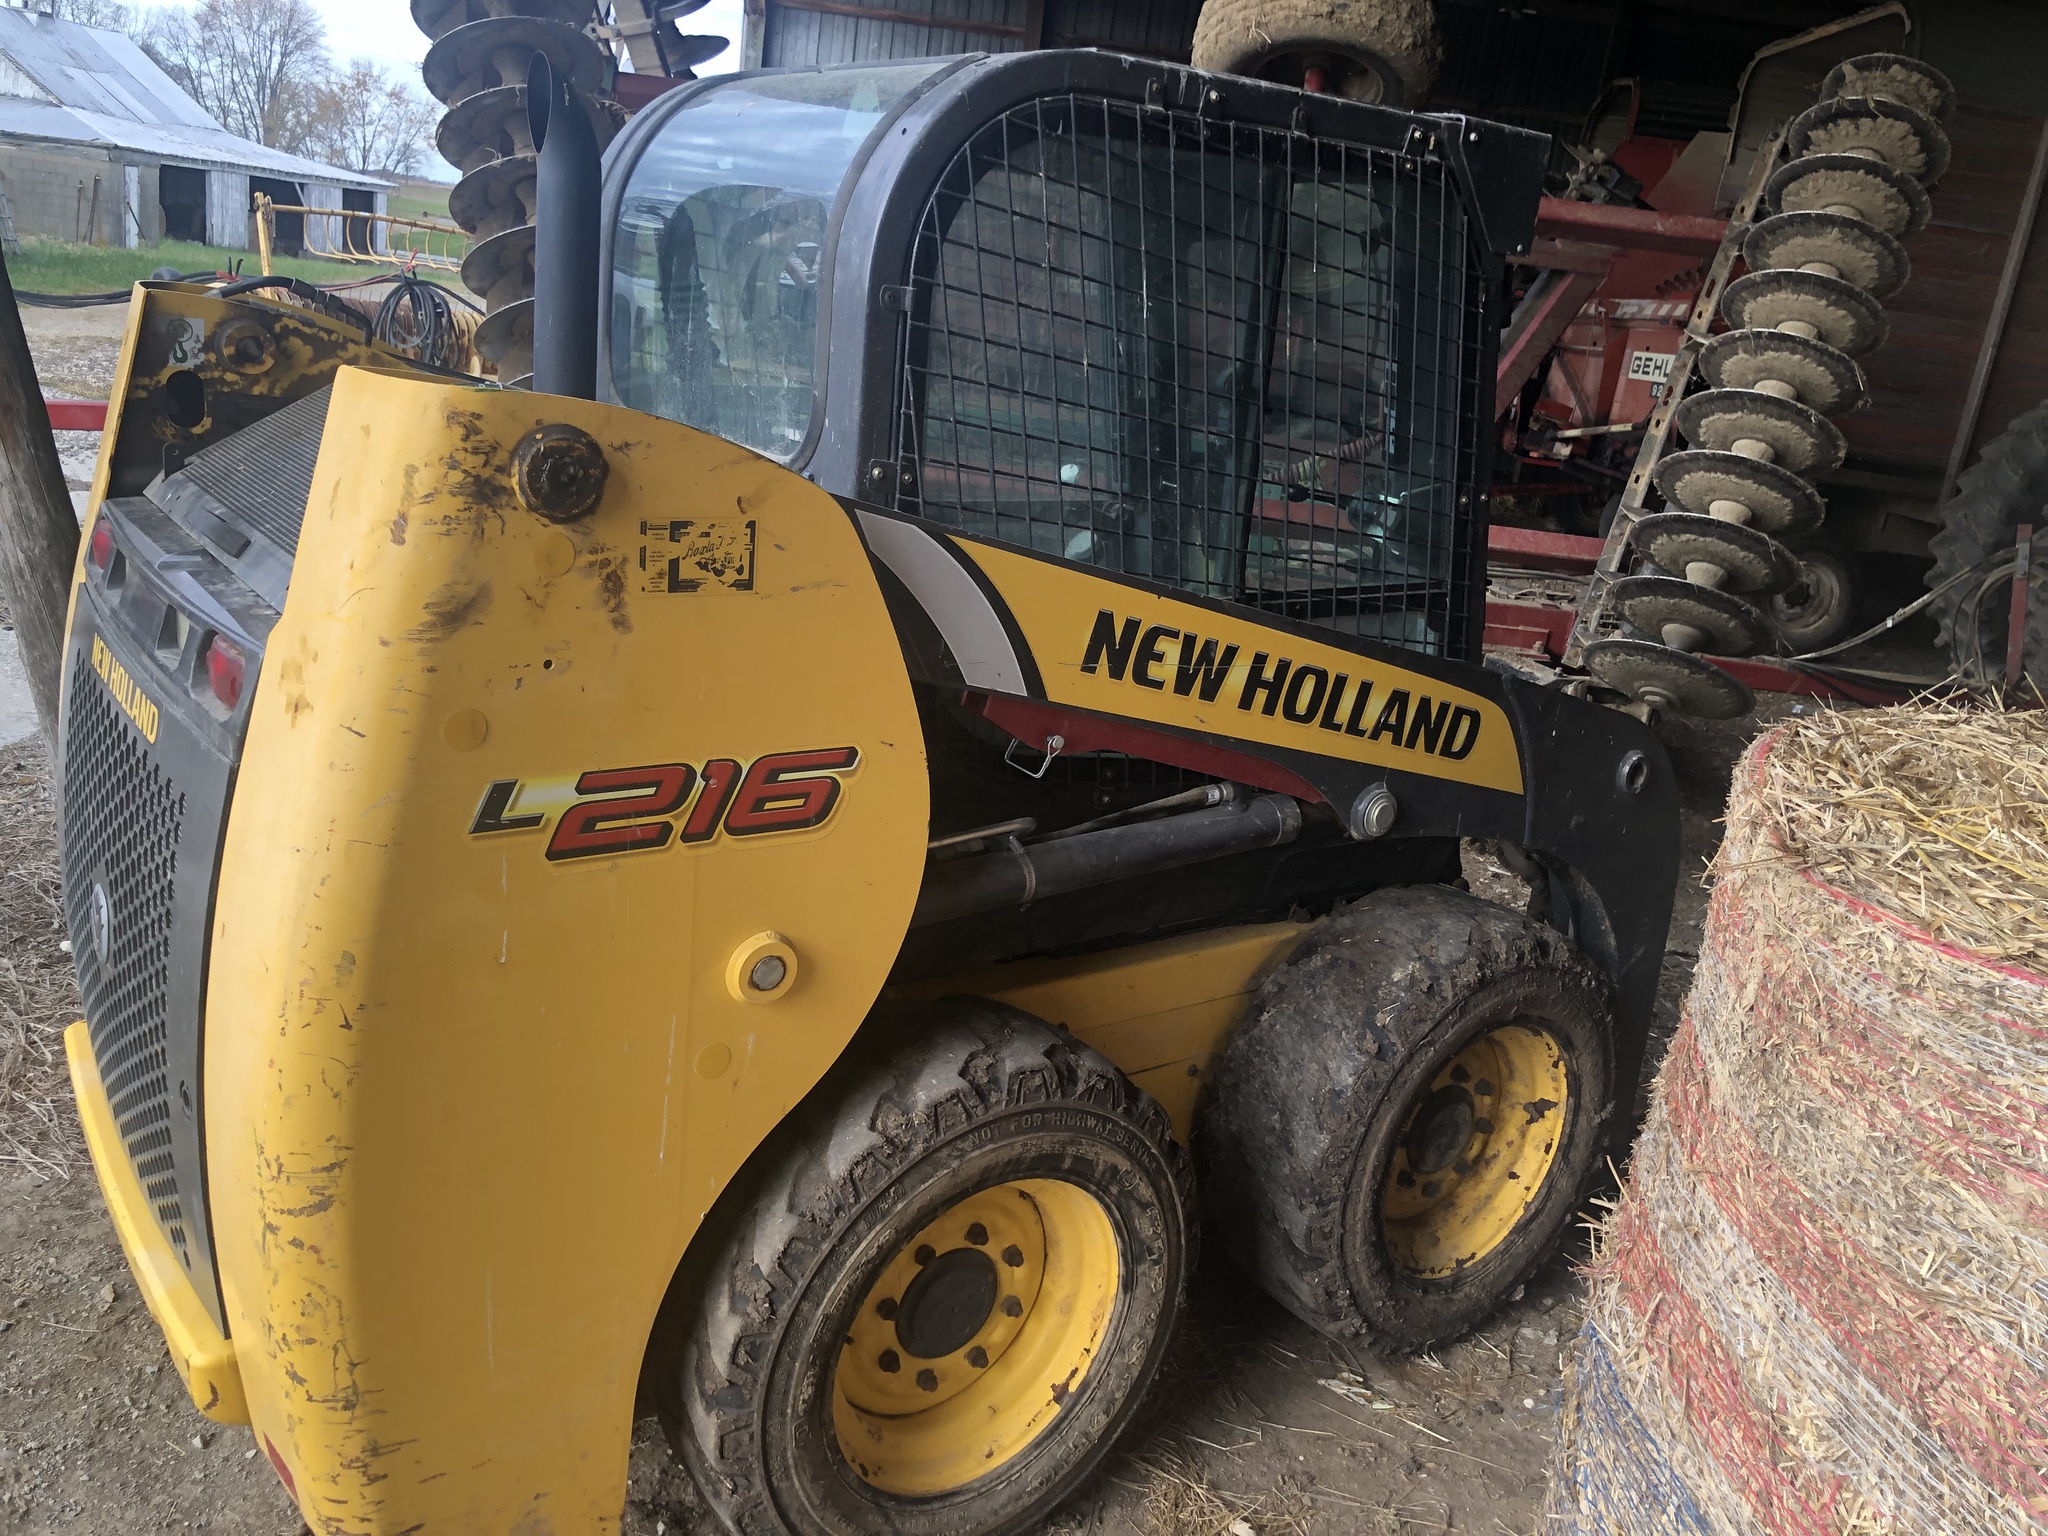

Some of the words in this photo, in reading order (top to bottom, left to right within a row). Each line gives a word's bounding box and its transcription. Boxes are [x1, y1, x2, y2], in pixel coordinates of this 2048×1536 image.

[1631, 356, 1671, 378] GEHL
[92, 632, 112, 684] NEW
[109, 656, 159, 744] HOLLAND
[1080, 608, 1240, 703] NEW
[1237, 651, 1481, 761] HOLLAND
[968, 1126, 999, 1147] NOT
[1011, 1114, 1042, 1131] FOR
[1051, 1112, 1113, 1134] HIGHWAY
